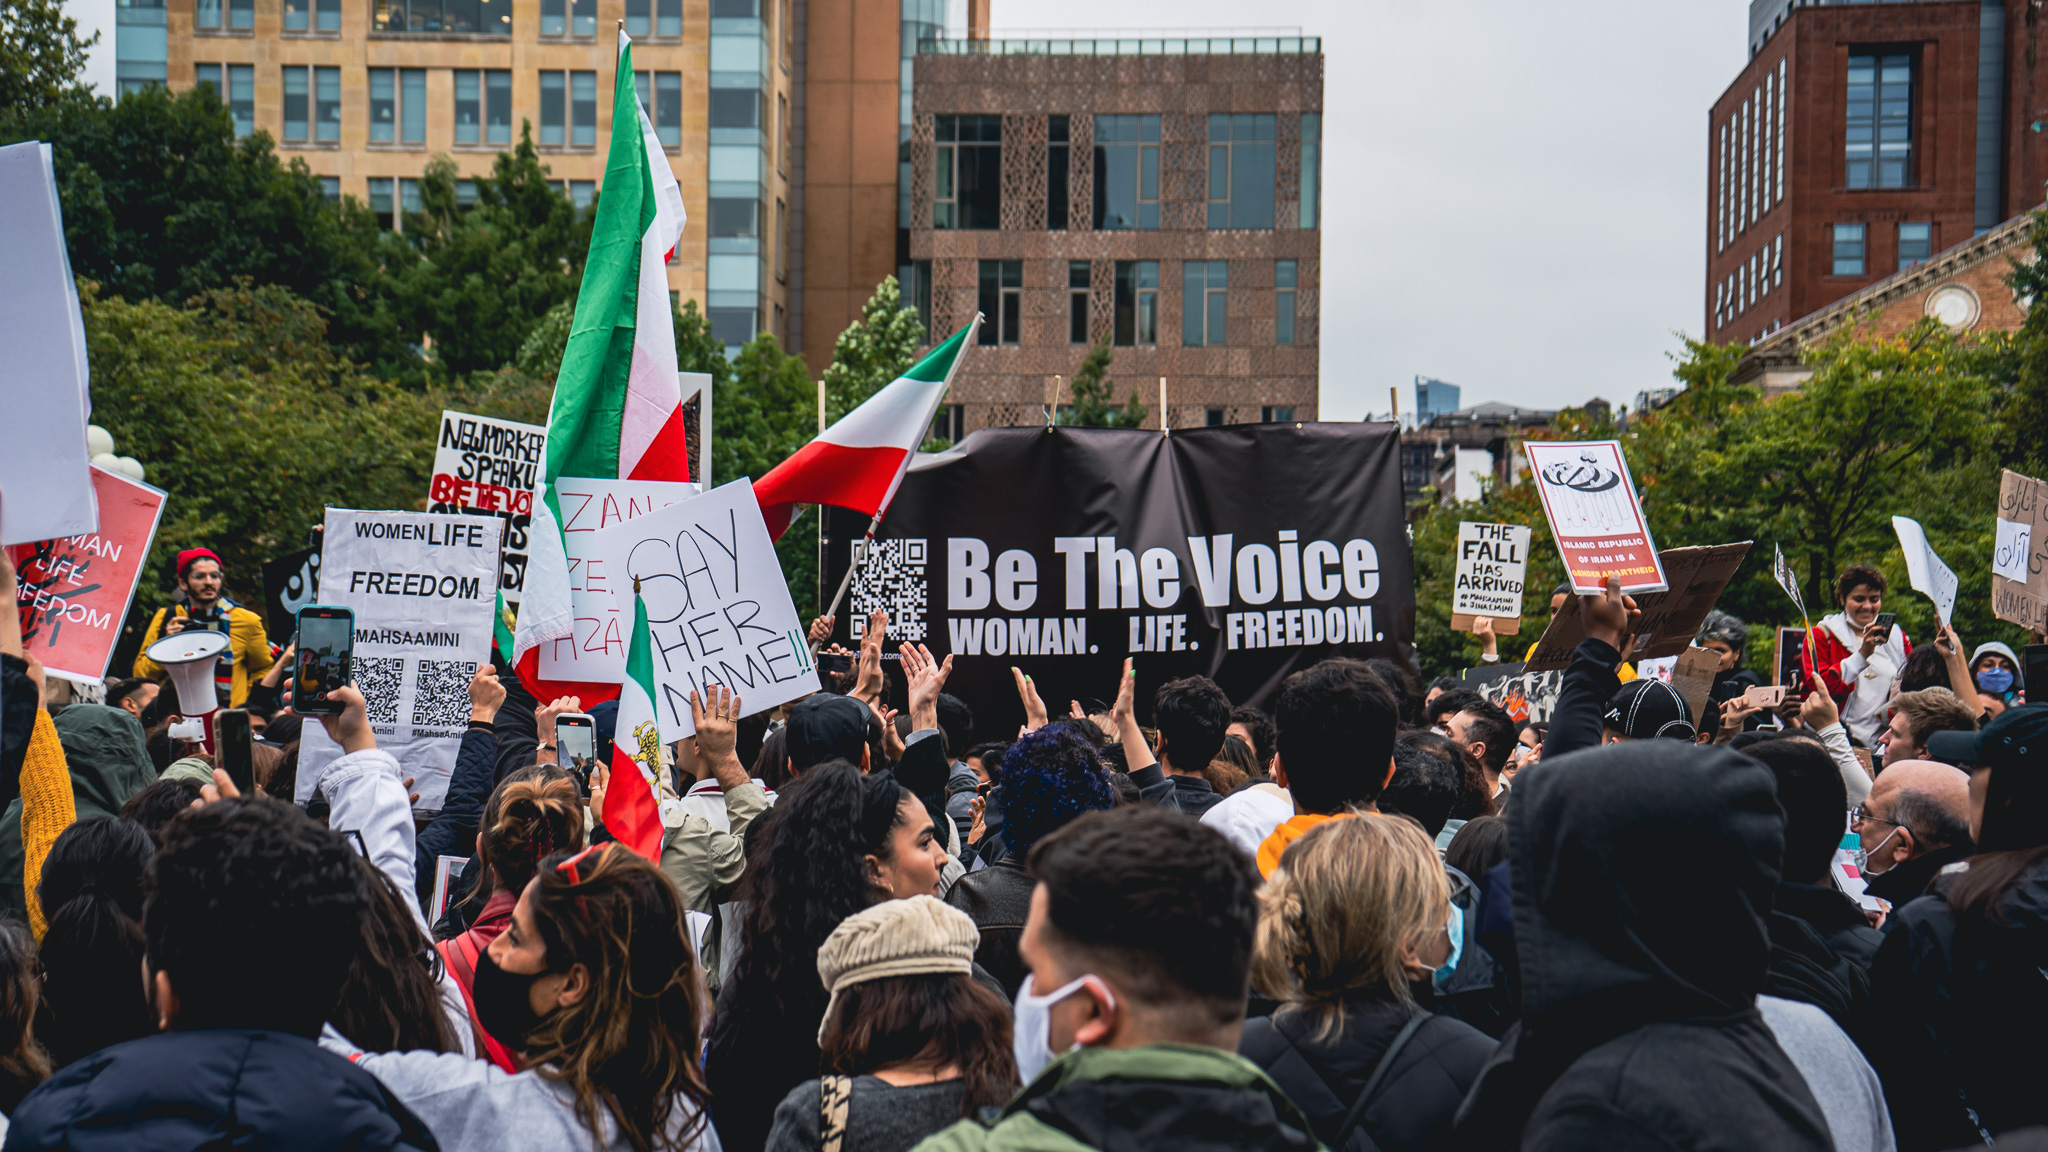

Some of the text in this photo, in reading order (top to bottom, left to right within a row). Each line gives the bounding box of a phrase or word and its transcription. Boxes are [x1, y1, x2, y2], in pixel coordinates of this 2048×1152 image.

[355, 522, 426, 540] WOMEN
[428, 523, 484, 547] LIFE
[1475, 524, 1515, 541] THE
[1563, 537, 1644, 549] ISLAMIC REPUBLIC
[1463, 540, 1521, 564] FALL
[1578, 552, 1636, 564] OF IRAN IS A
[35, 555, 88, 587] LIFE
[627, 509, 739, 624] SAY
[947, 529, 1381, 611] Be The Voice
[1472, 562, 1503, 577] HAS
[1571, 569, 1601, 578] GENDER
[350, 571, 479, 599] FREEDOM
[1457, 573, 1522, 593] ARRIVED
[1995, 588, 2032, 623] WOMEN
[353, 629, 459, 647] MAHSAAMINI
[651, 600, 777, 673] HER
[948, 605, 1384, 656] WOMAN. LIFE. FREEDOM.
[662, 629, 812, 726] NAME!!
